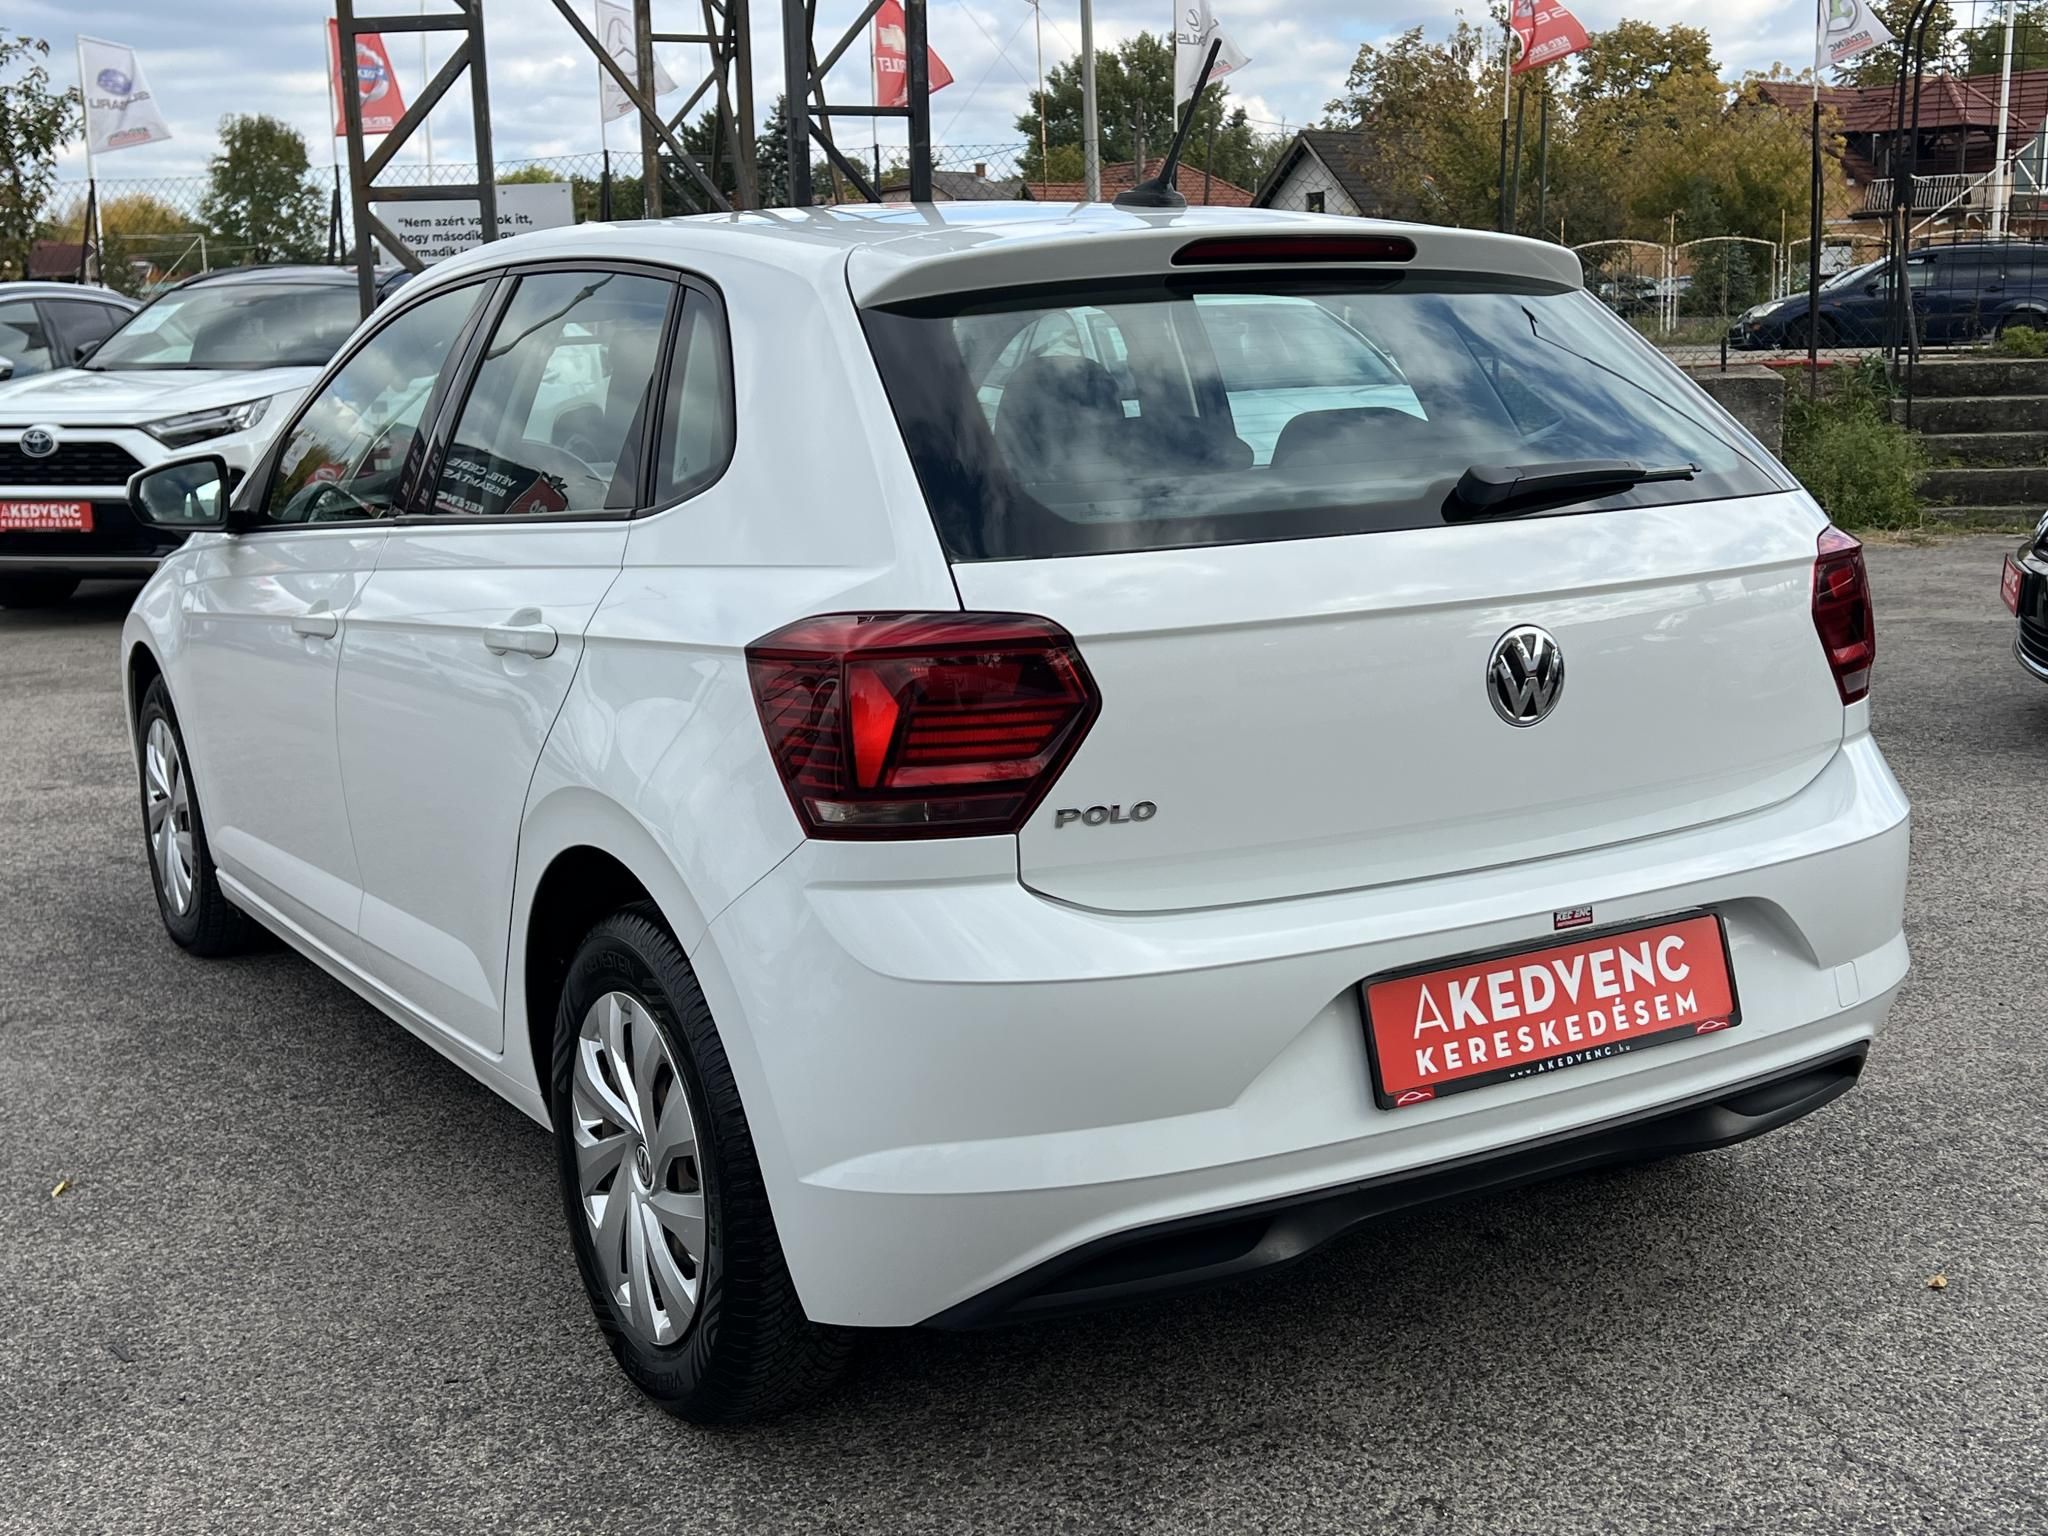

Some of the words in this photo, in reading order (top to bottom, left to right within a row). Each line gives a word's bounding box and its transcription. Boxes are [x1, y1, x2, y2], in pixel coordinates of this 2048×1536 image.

[434, 216, 465, 227] azért
[468, 214, 512, 226] vaok
[515, 213, 533, 226] itt,
[400, 233, 429, 245] hogy
[432, 230, 484, 242] második
[410, 246, 457, 258] rmadik
[1055, 800, 1158, 829] POLO
[1415, 988, 1699, 1077] KERESKEDÉSEM
